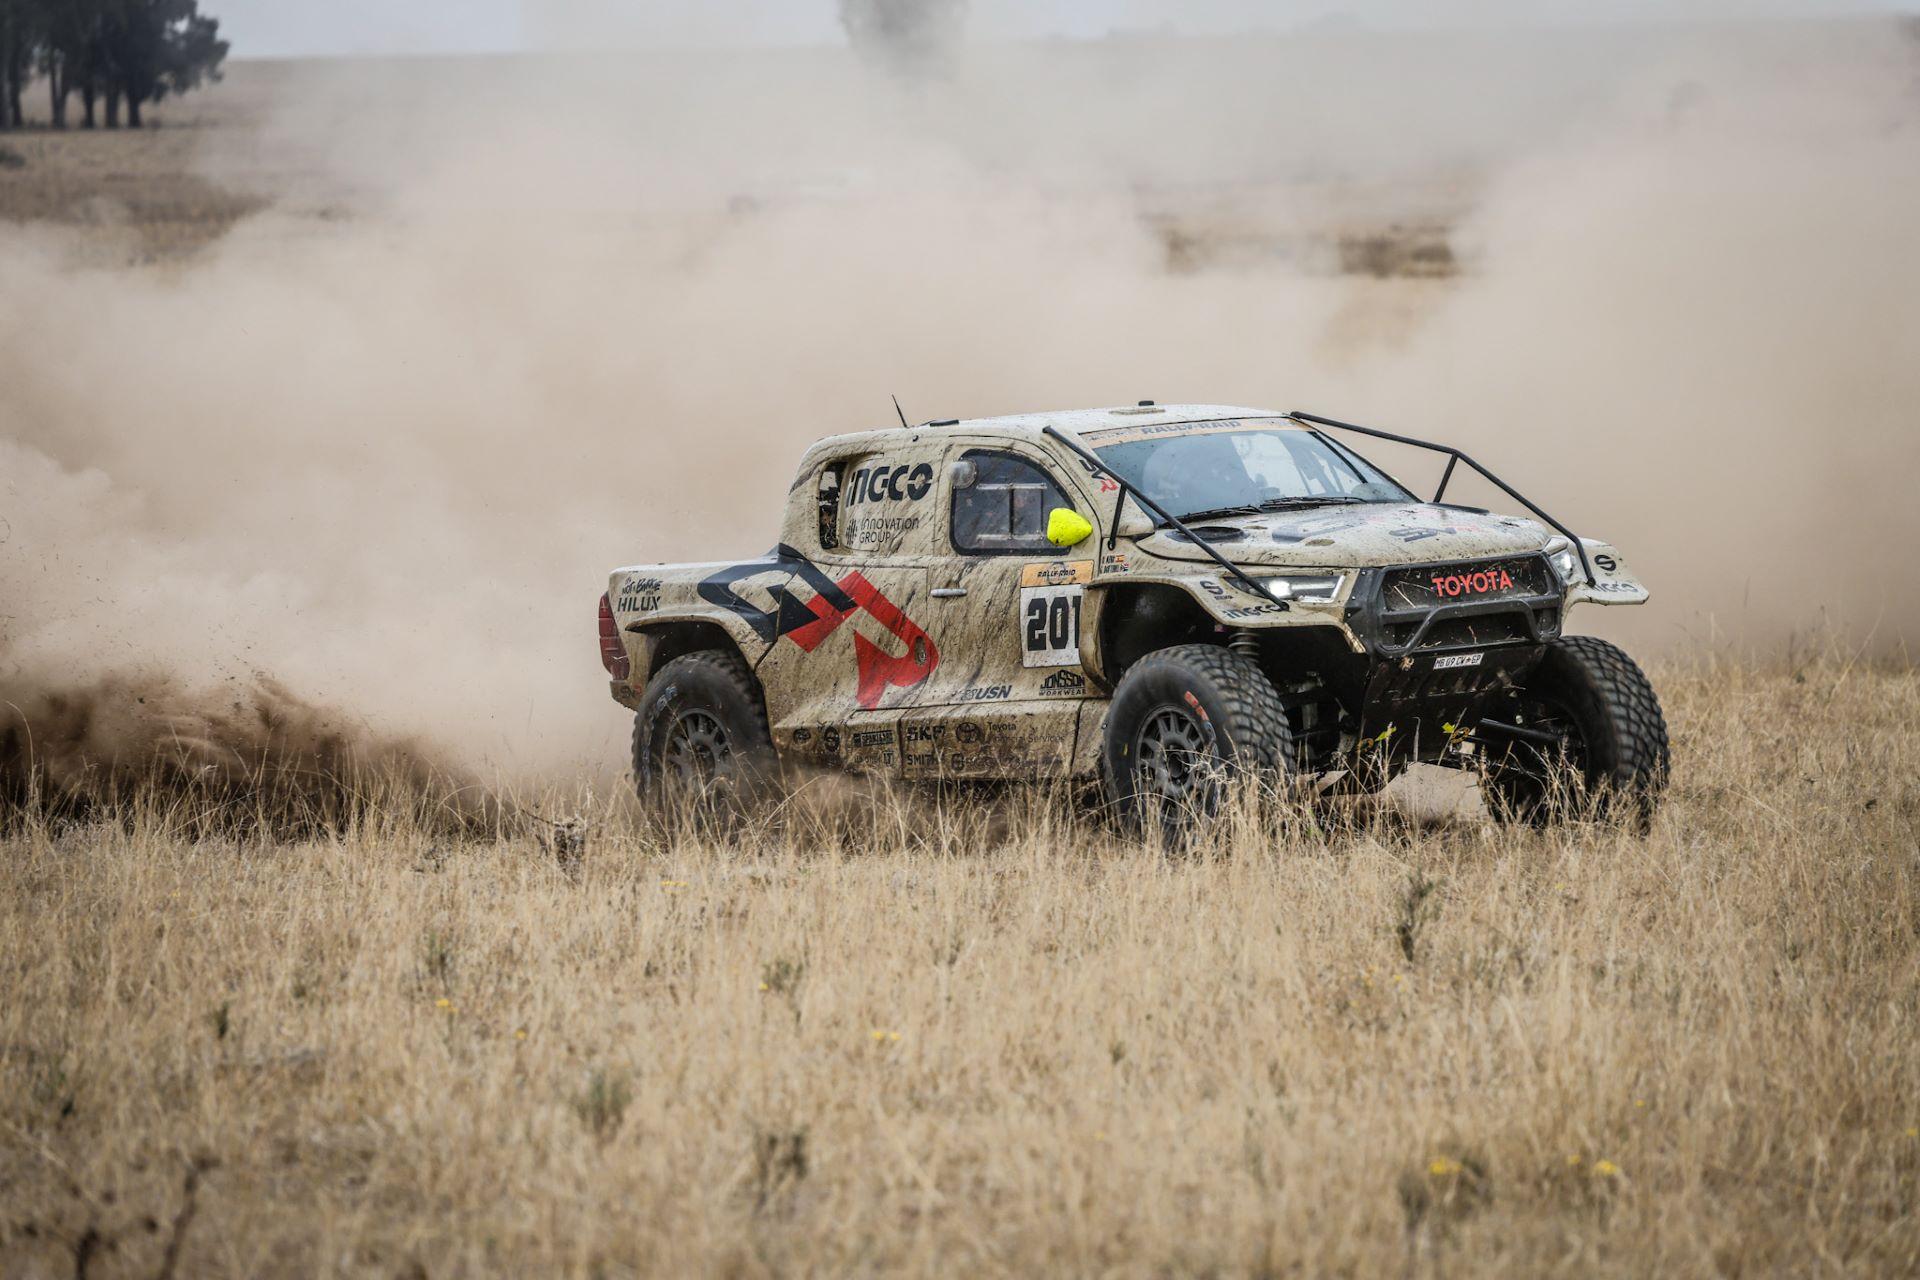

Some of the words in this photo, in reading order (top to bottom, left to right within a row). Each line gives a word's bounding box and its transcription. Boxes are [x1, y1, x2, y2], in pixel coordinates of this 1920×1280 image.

[860, 531, 891, 544] GROUP
[1432, 570, 1513, 597] TOYOTA
[618, 596, 661, 612] HILUX
[1027, 596, 1082, 651] 201
[1040, 669, 1085, 689] JONSSON
[975, 685, 1012, 699] USN
[906, 725, 945, 741] SKF
[987, 722, 1017, 731] Toyota
